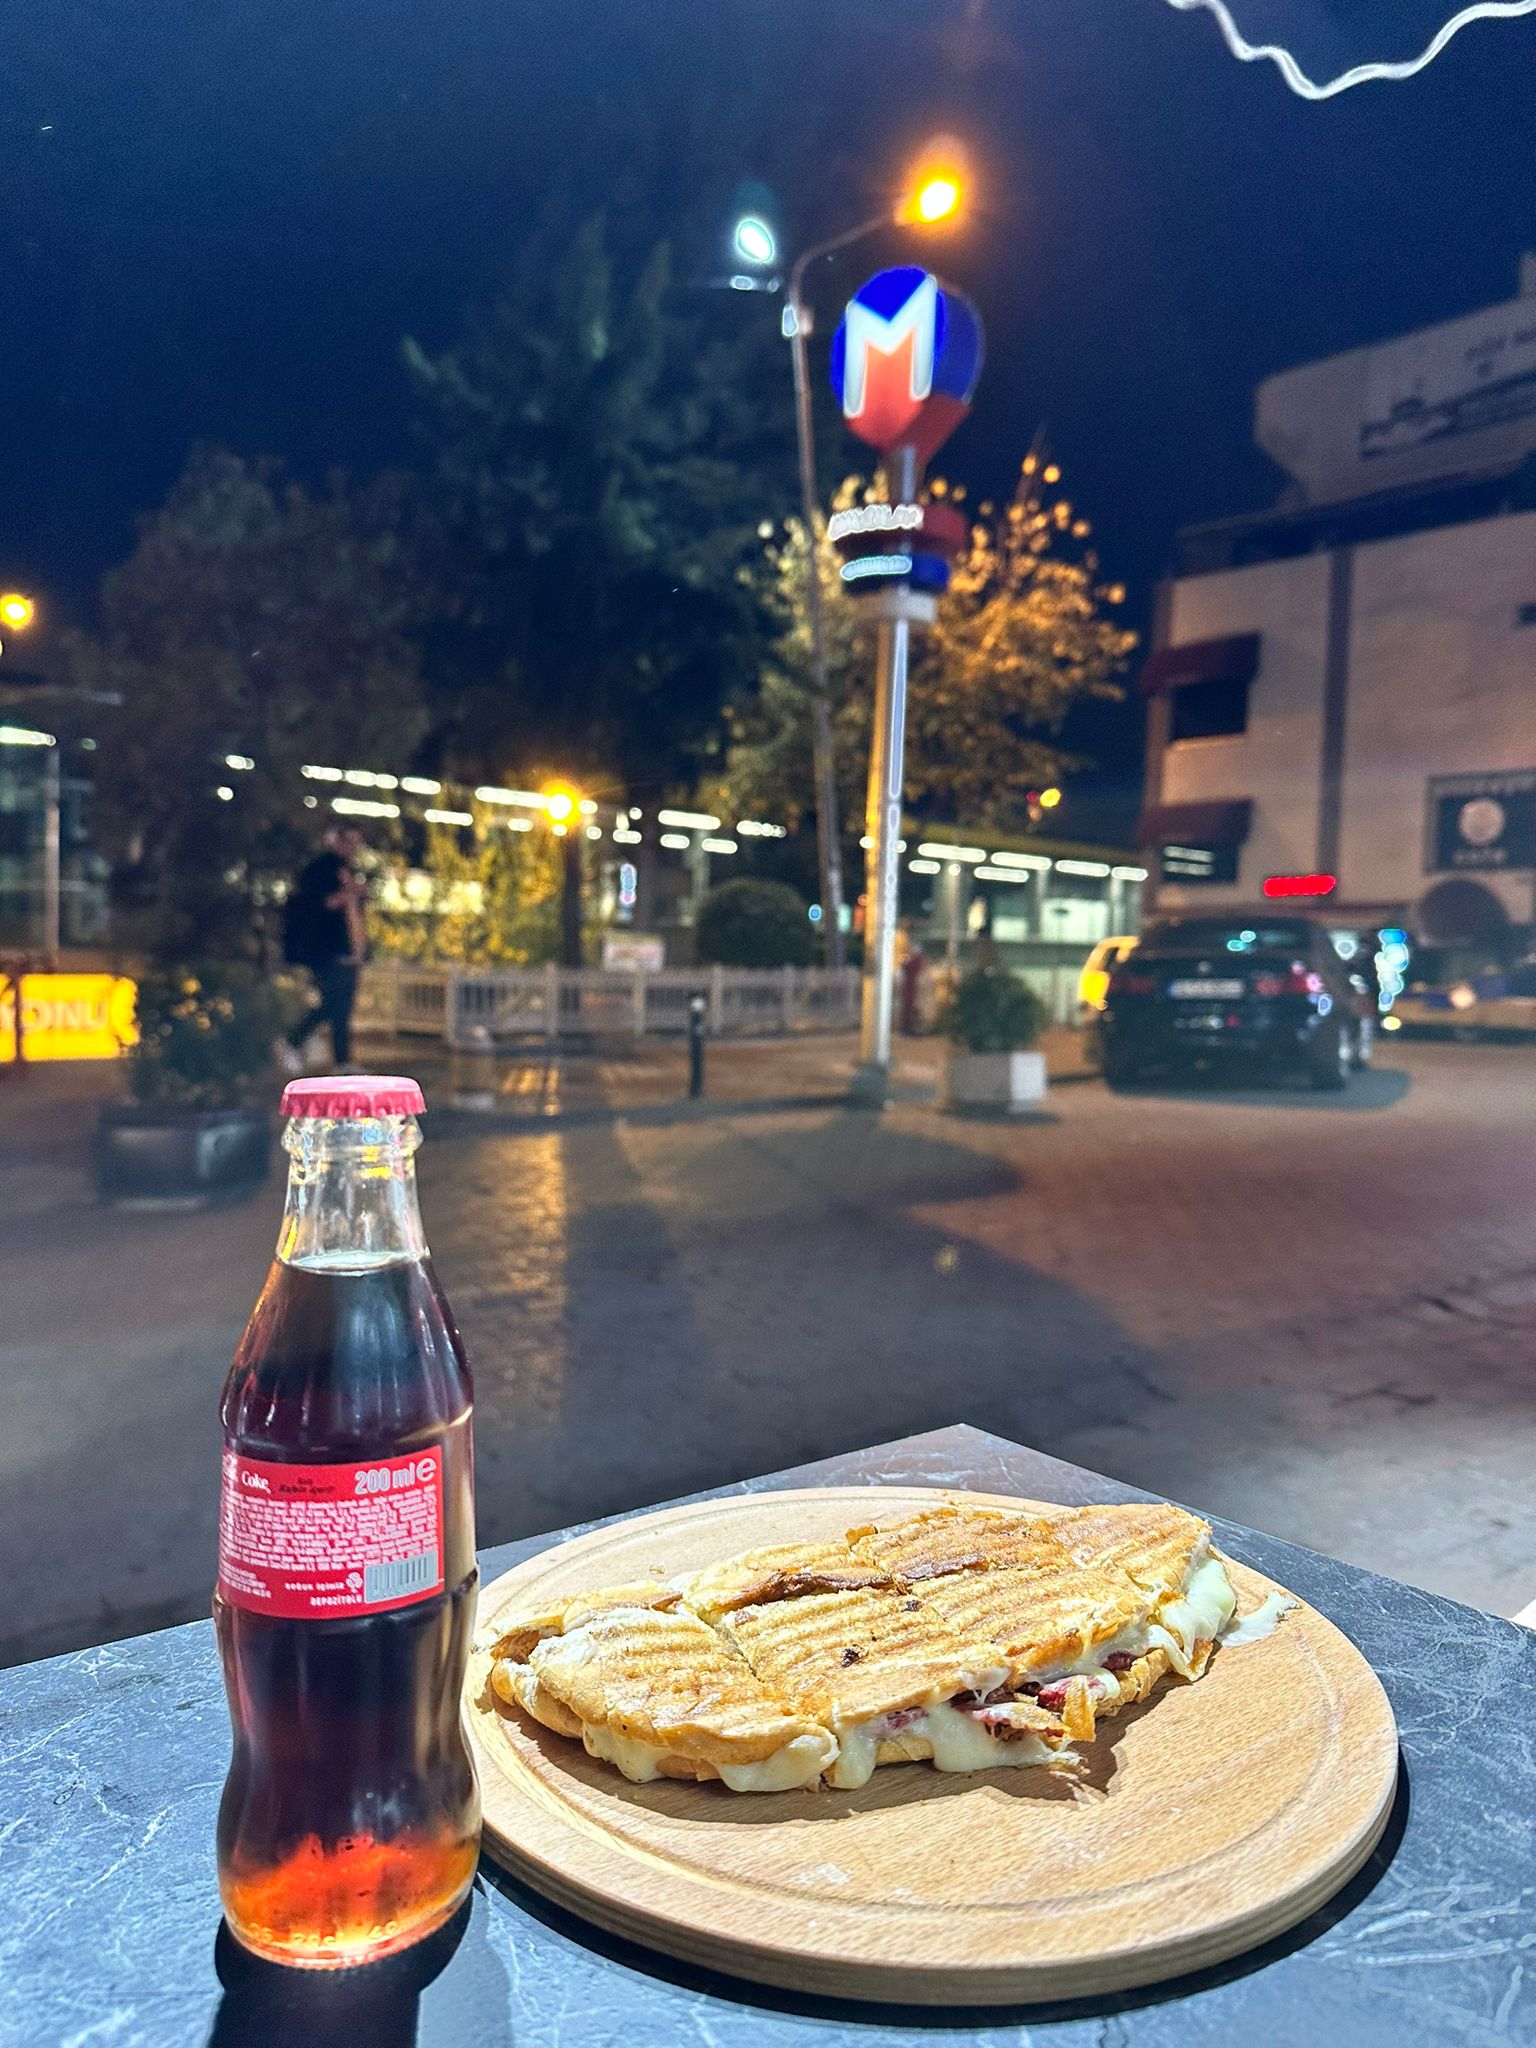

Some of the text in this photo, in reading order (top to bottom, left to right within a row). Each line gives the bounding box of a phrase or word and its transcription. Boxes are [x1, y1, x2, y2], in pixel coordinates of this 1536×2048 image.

[843, 274, 937, 418] M
[241, 1470, 271, 1494] Coke
[355, 1468, 391, 1495] 200
[392, 1461, 416, 1489] ml
